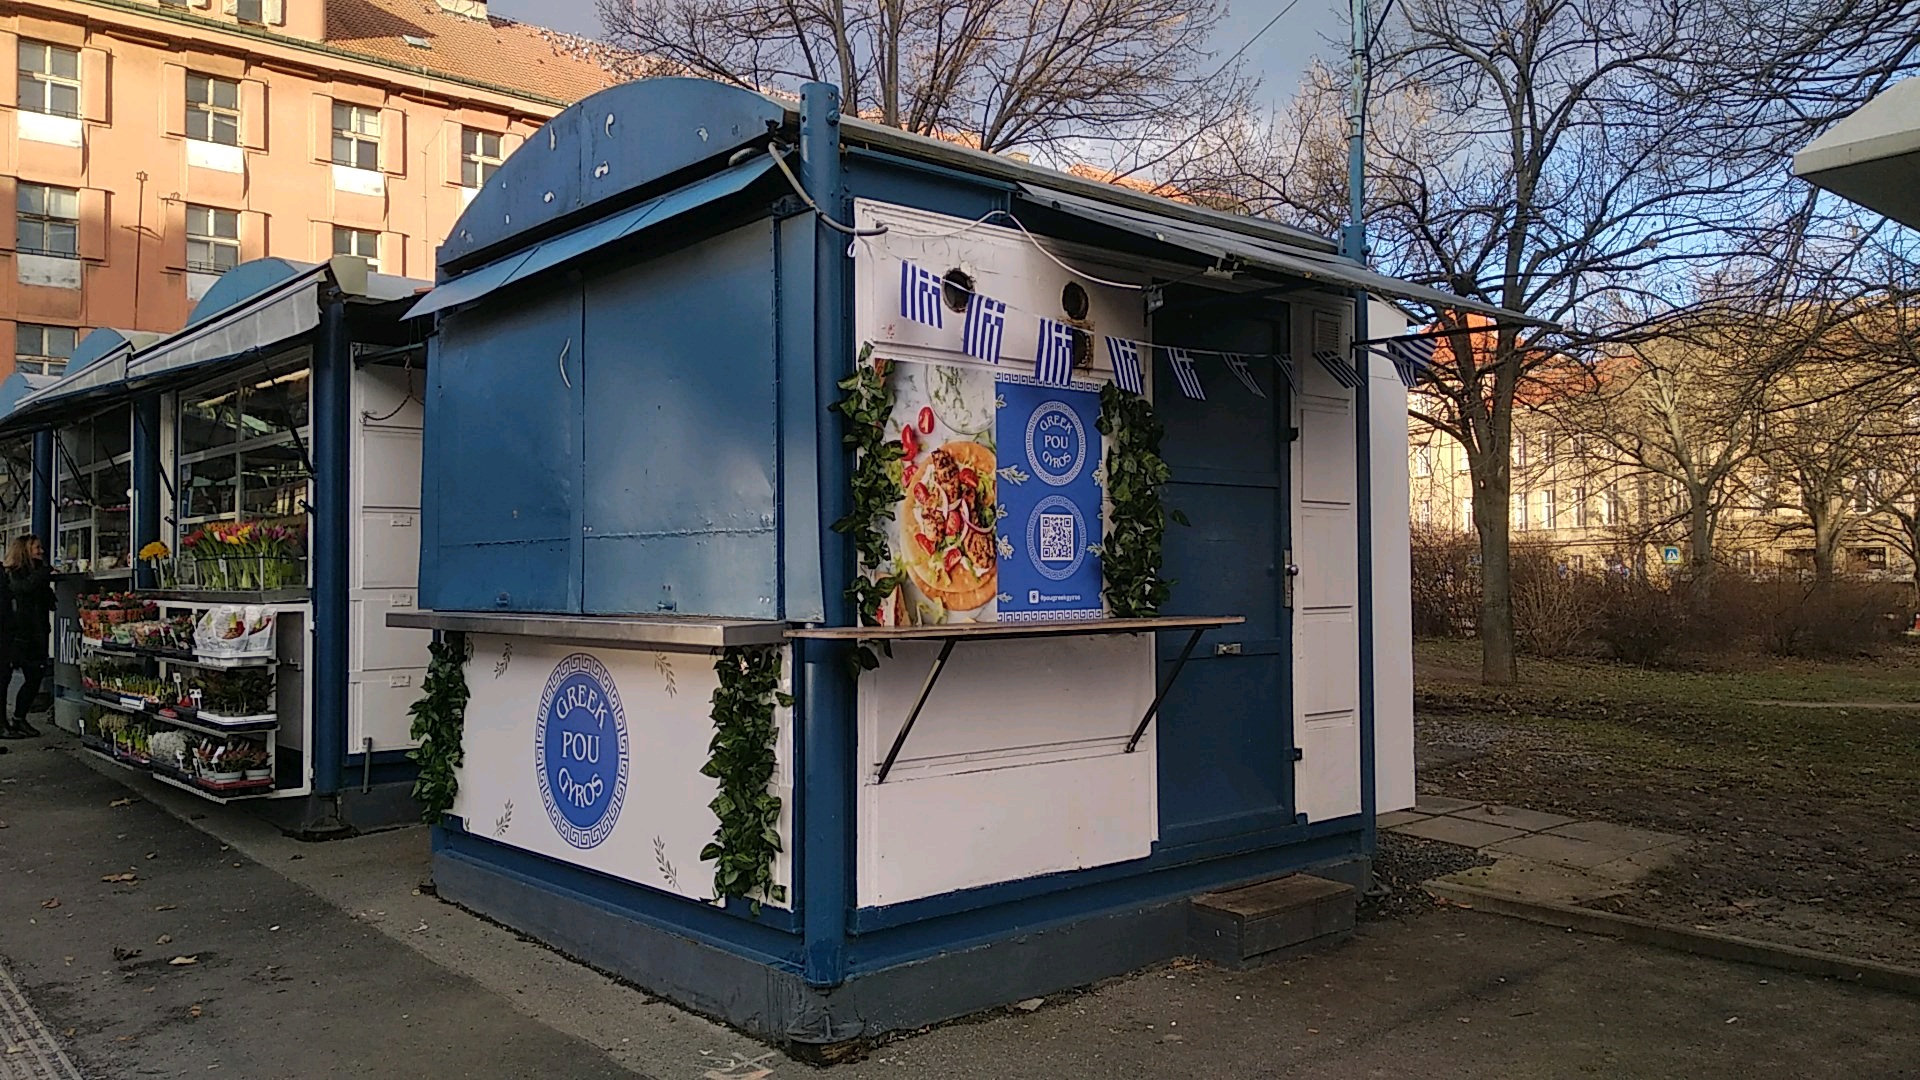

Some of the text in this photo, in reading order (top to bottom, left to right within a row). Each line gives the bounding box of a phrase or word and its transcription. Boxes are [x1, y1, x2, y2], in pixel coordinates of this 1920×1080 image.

[1039, 414, 1073, 435] GREEK
[1044, 435, 1069, 449] POU
[1042, 451, 1072, 468] GYROS
[60, 617, 95, 664] Kios
[556, 684, 608, 730] GREEK
[561, 731, 600, 764] POU
[558, 767, 604, 809] GYROS
